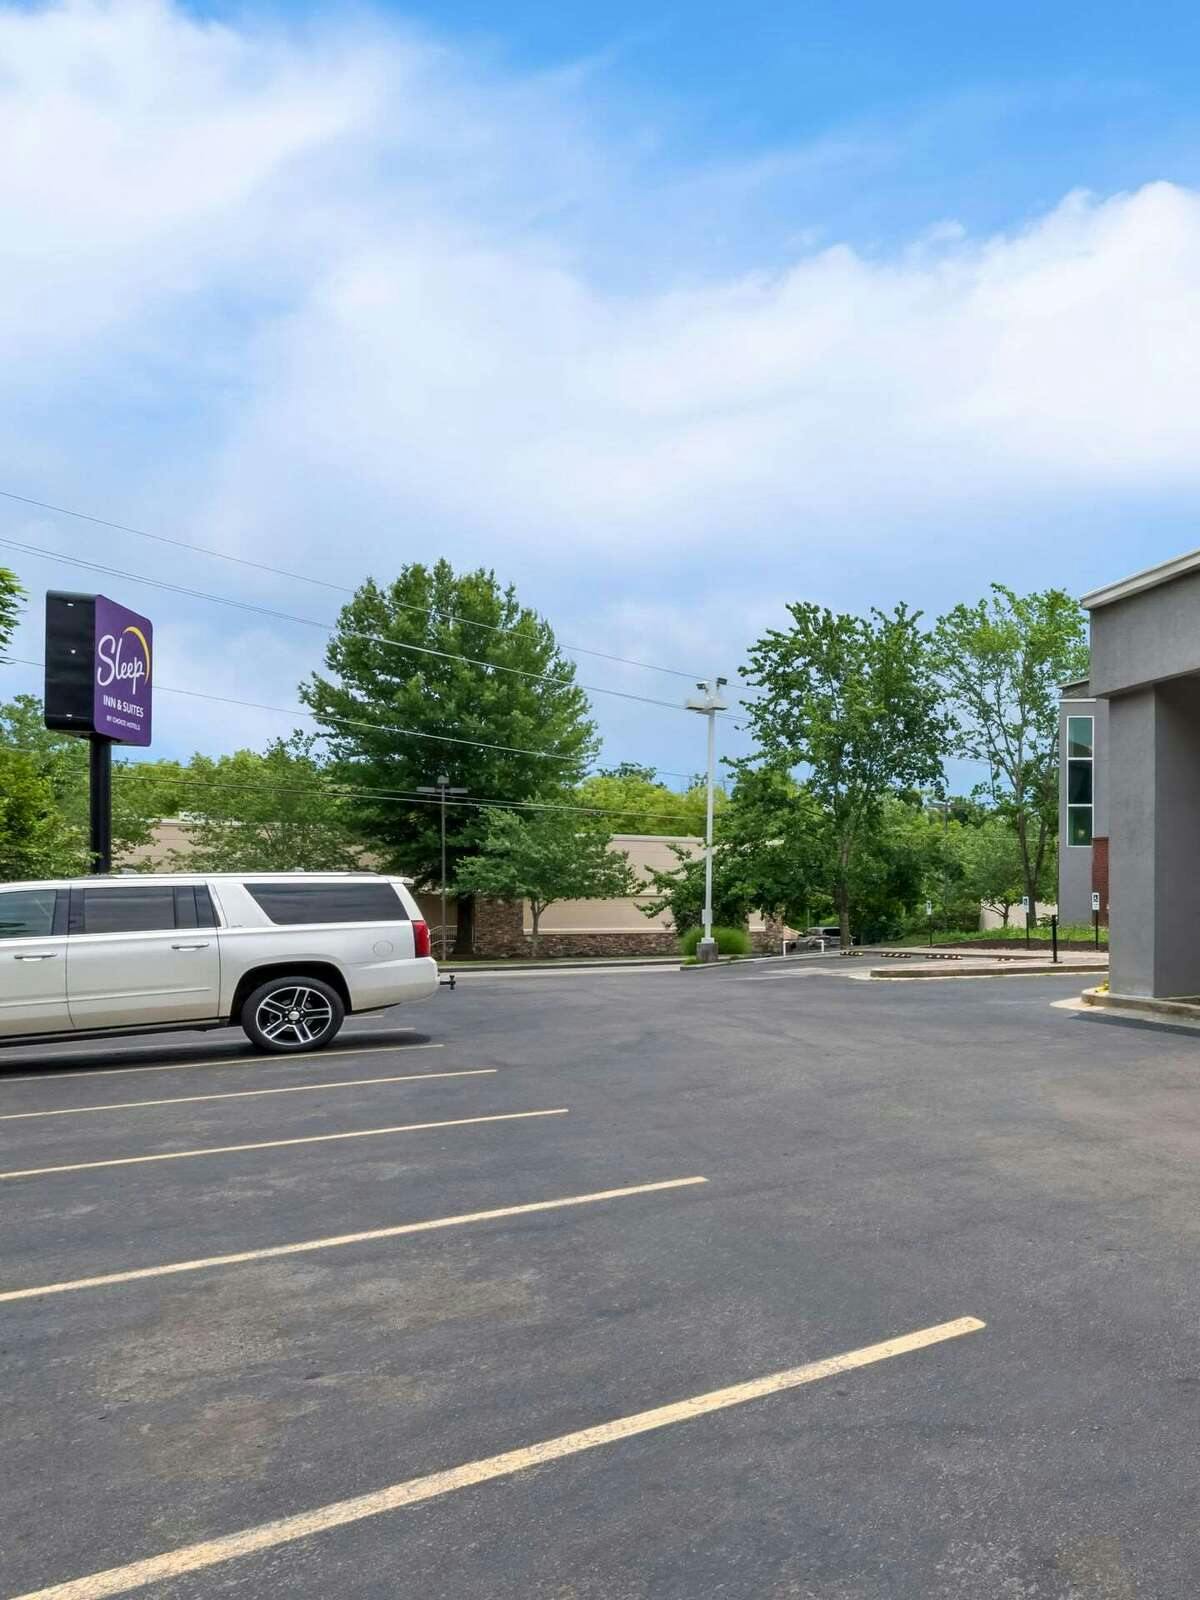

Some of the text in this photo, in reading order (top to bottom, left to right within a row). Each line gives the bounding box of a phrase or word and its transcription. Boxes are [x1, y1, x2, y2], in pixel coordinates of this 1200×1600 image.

[97, 634, 144, 695] Sleep
[103, 694, 144, 718] INN & SUITES
